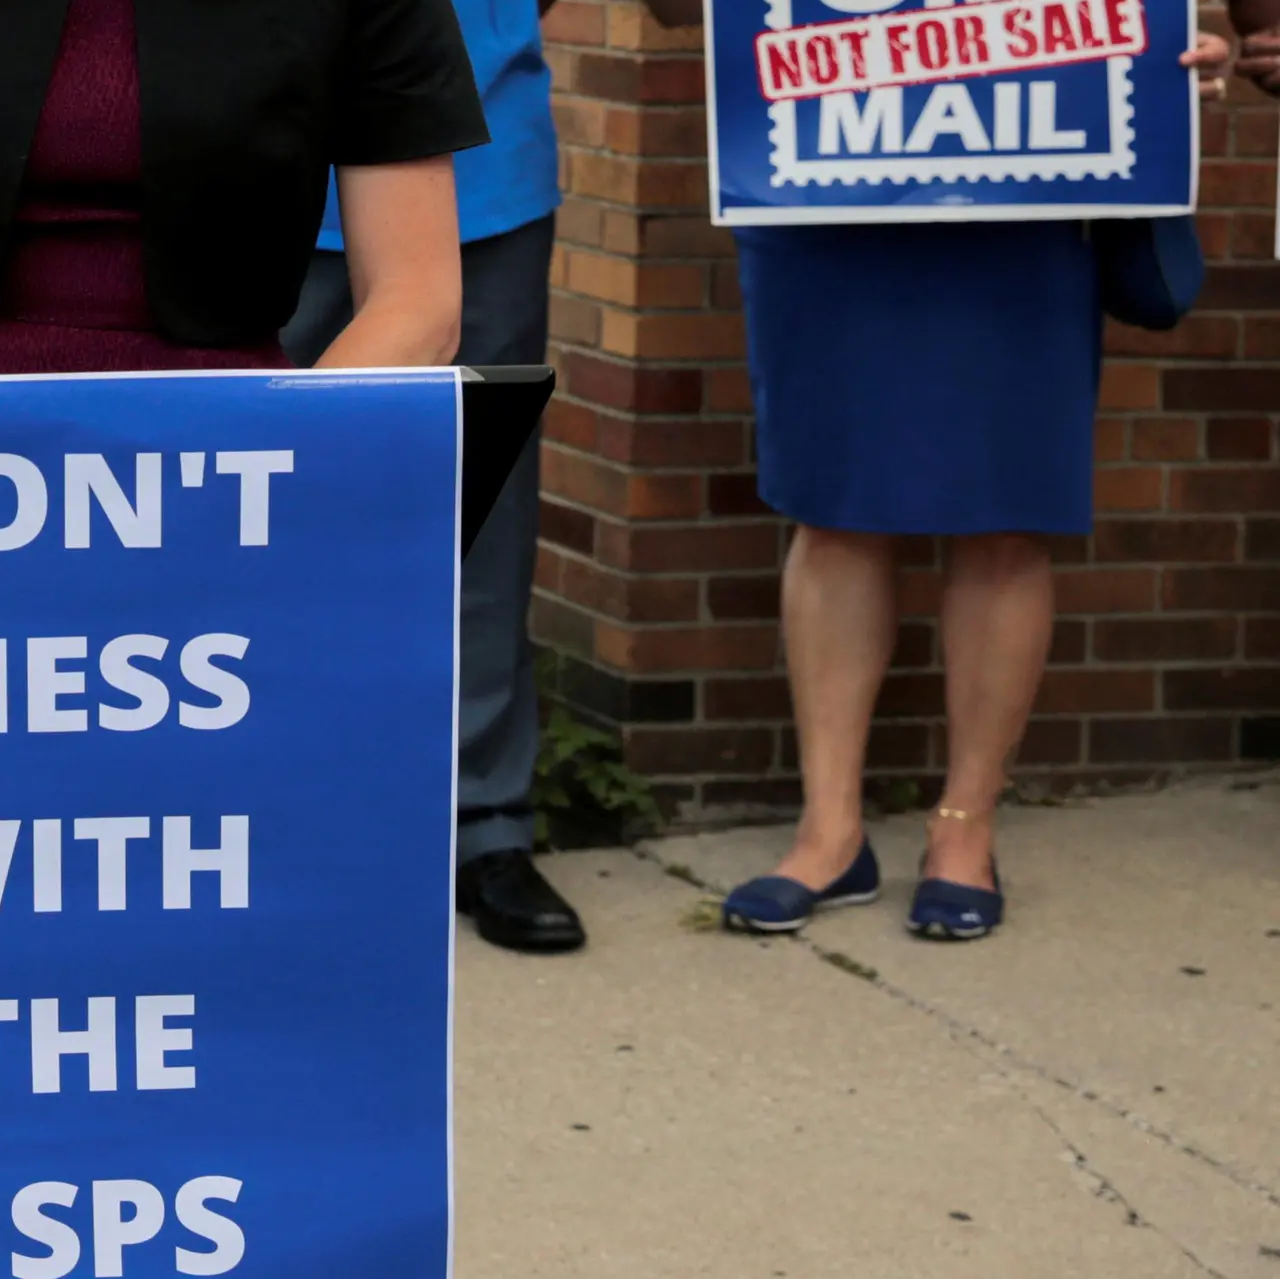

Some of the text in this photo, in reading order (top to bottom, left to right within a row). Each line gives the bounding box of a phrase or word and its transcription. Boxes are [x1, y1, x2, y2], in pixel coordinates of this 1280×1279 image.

[767, 28, 870, 89] NOT
[887, 16, 989, 74] FOR
[818, 81, 1086, 155] MAIL
